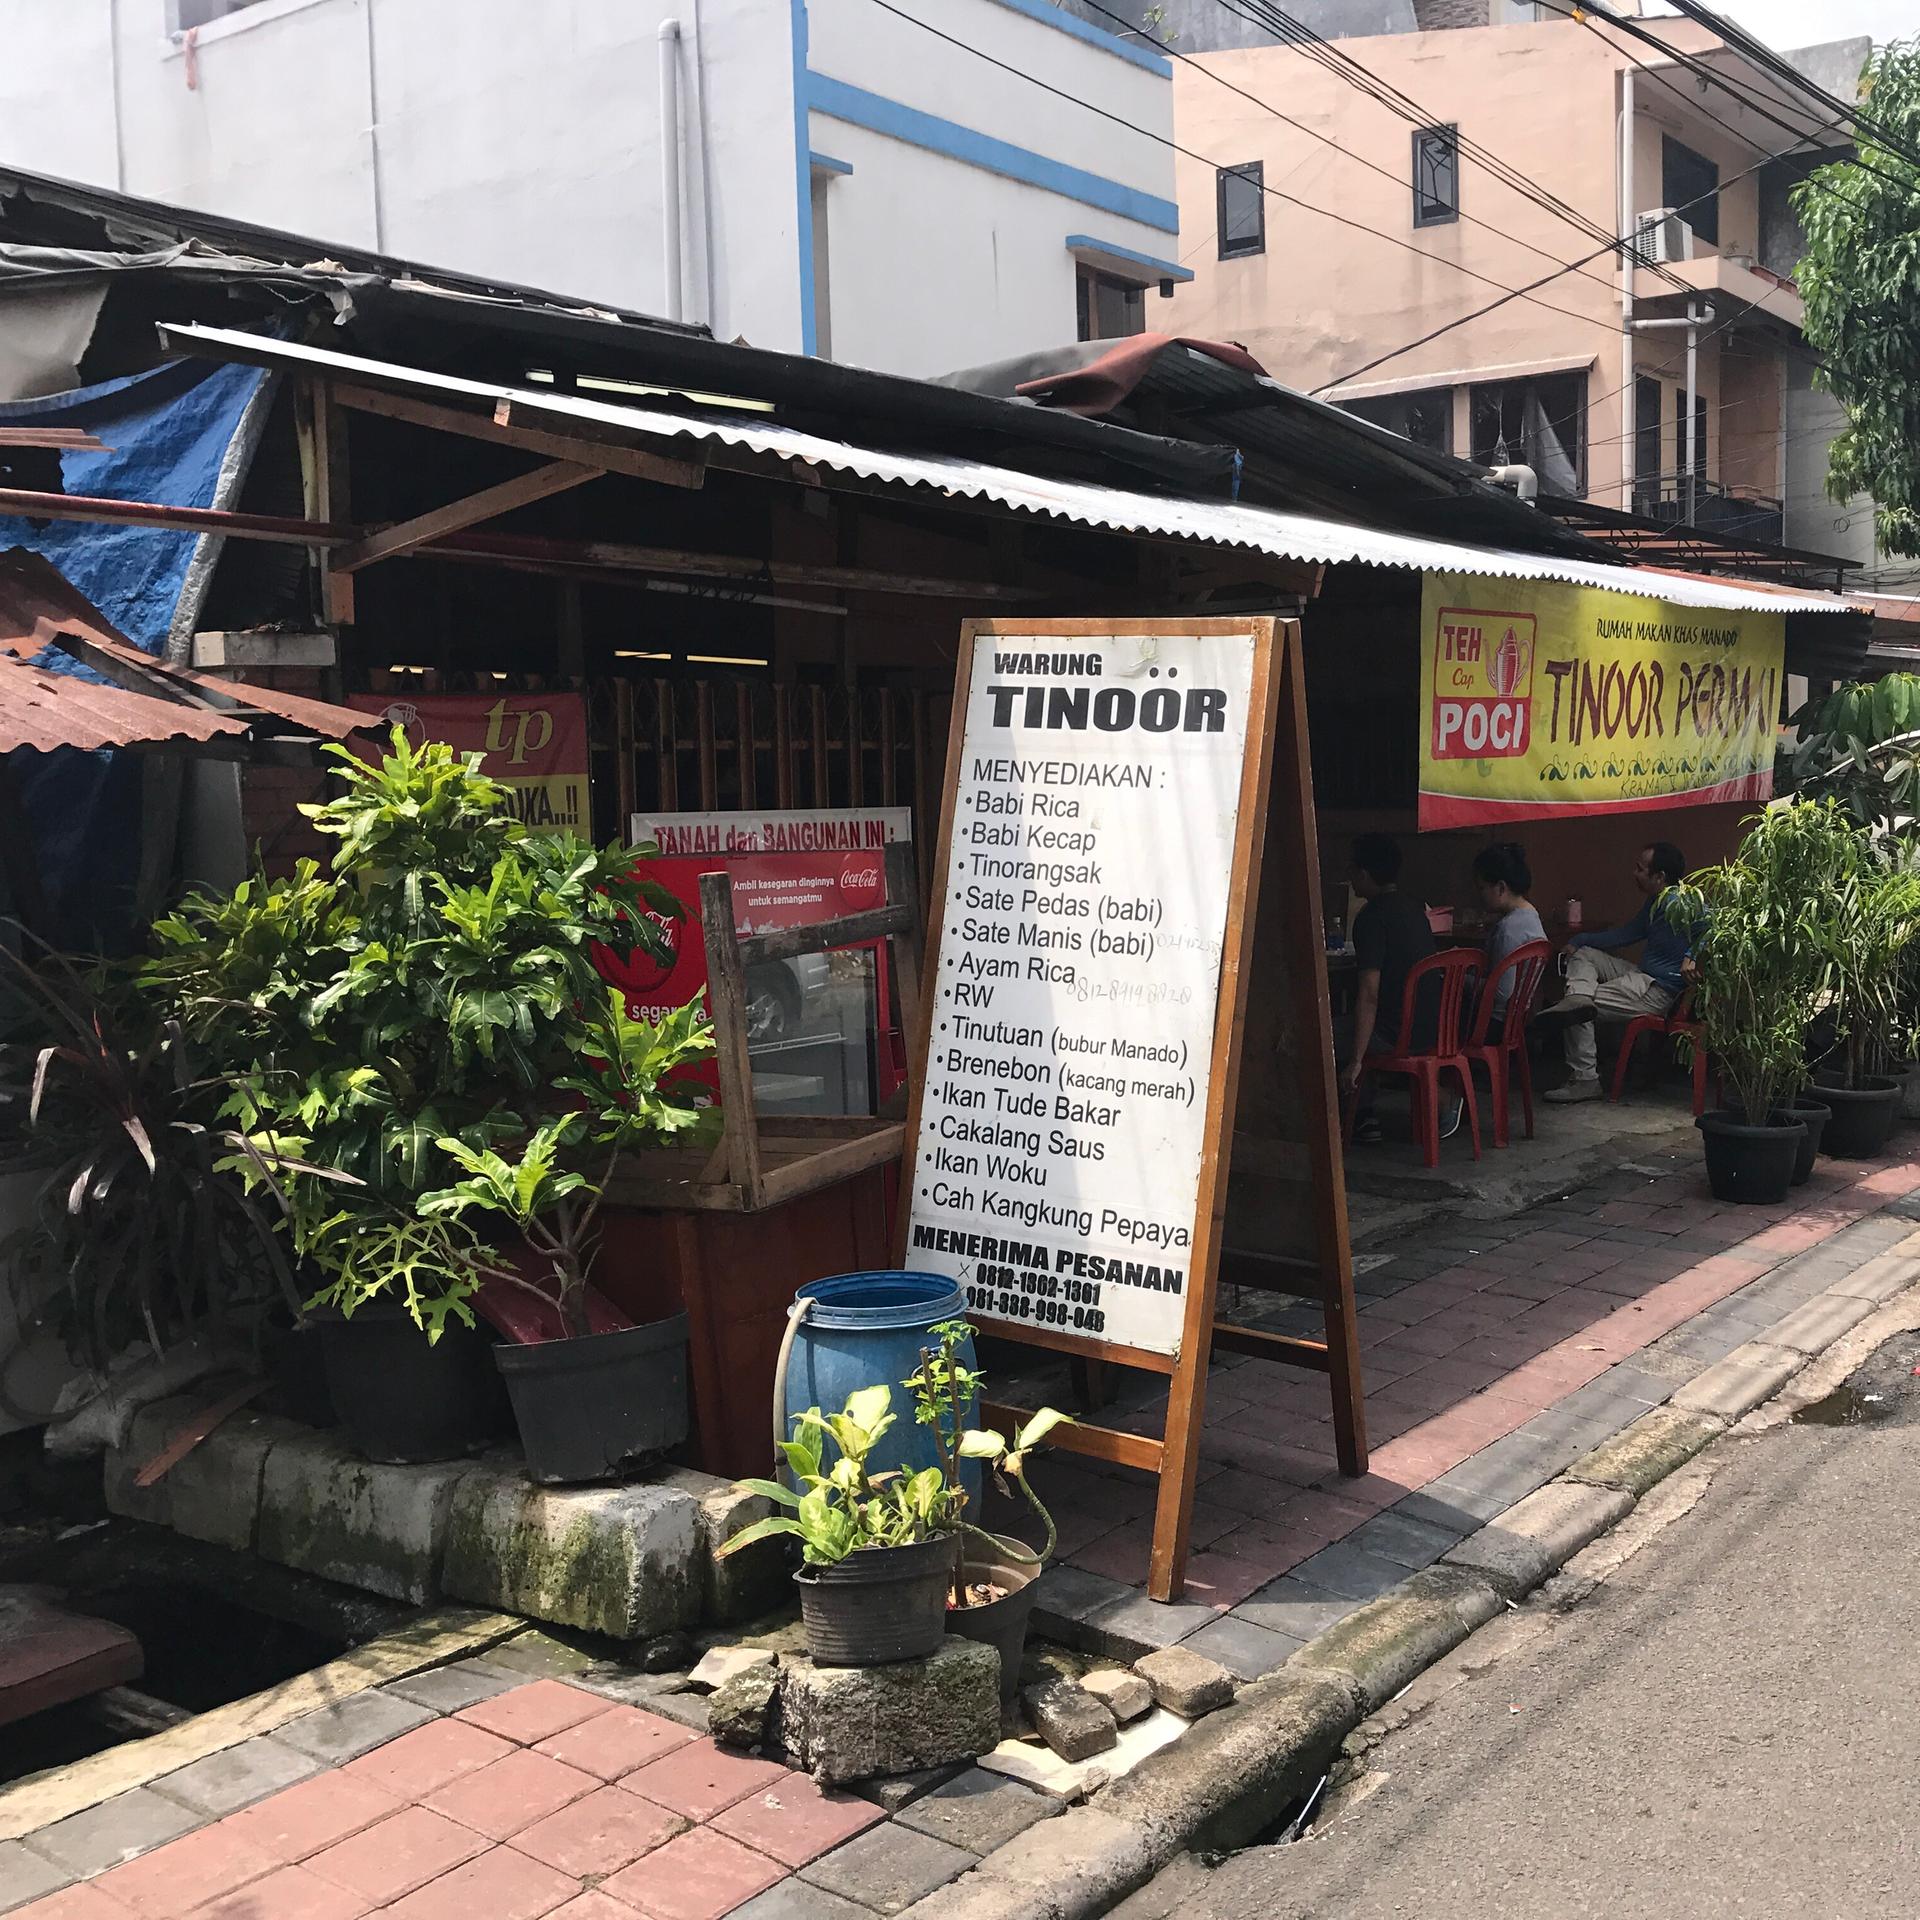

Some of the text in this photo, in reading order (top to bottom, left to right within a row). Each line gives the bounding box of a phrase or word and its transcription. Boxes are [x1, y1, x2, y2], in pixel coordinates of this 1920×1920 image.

[1443, 625, 1482, 662] TEH
[1596, 618, 1738, 648] RUMAH MAKAN KHAS MANADO
[994, 653, 1102, 676] WARUNG
[1452, 668, 1474, 689] Cap
[1545, 657, 1665, 747] TINOOR
[484, 698, 553, 764] tp
[1438, 702, 1525, 751] POCI
[973, 759, 1152, 788] MENYEDIAKAN
[976, 790, 1079, 817] Babi Rica
[654, 825, 719, 853] TANAH
[764, 821, 860, 850] BANGUNAN
[865, 820, 885, 849] INI
[971, 822, 1095, 856] Babi Kecap
[733, 877, 835, 891] Ambil kesegaran dinginnya
[970, 853, 1101, 887] Tinorangsak
[748, 893, 822, 906] untuk semangatmu
[966, 886, 1162, 928] Sate Pedas (babi)
[962, 918, 1153, 962] Sate Manis (babi)
[958, 951, 1075, 983] Ayam Rica
[954, 983, 994, 1008] RW
[952, 1015, 1187, 1070] Tinutuan (bubur Manado)
[947, 1048, 1194, 1108] Brenebon (kacang merah)
[943, 1081, 1121, 1126] Ikan Tude Bakar
[940, 1115, 1104, 1160] Cakalang Saus
[935, 1147, 1047, 1186] Ikan Woku
[933, 1182, 1191, 1249] Cah Kangkung Pepaya
[913, 1224, 1183, 1295] MENERIMA PESANAN
